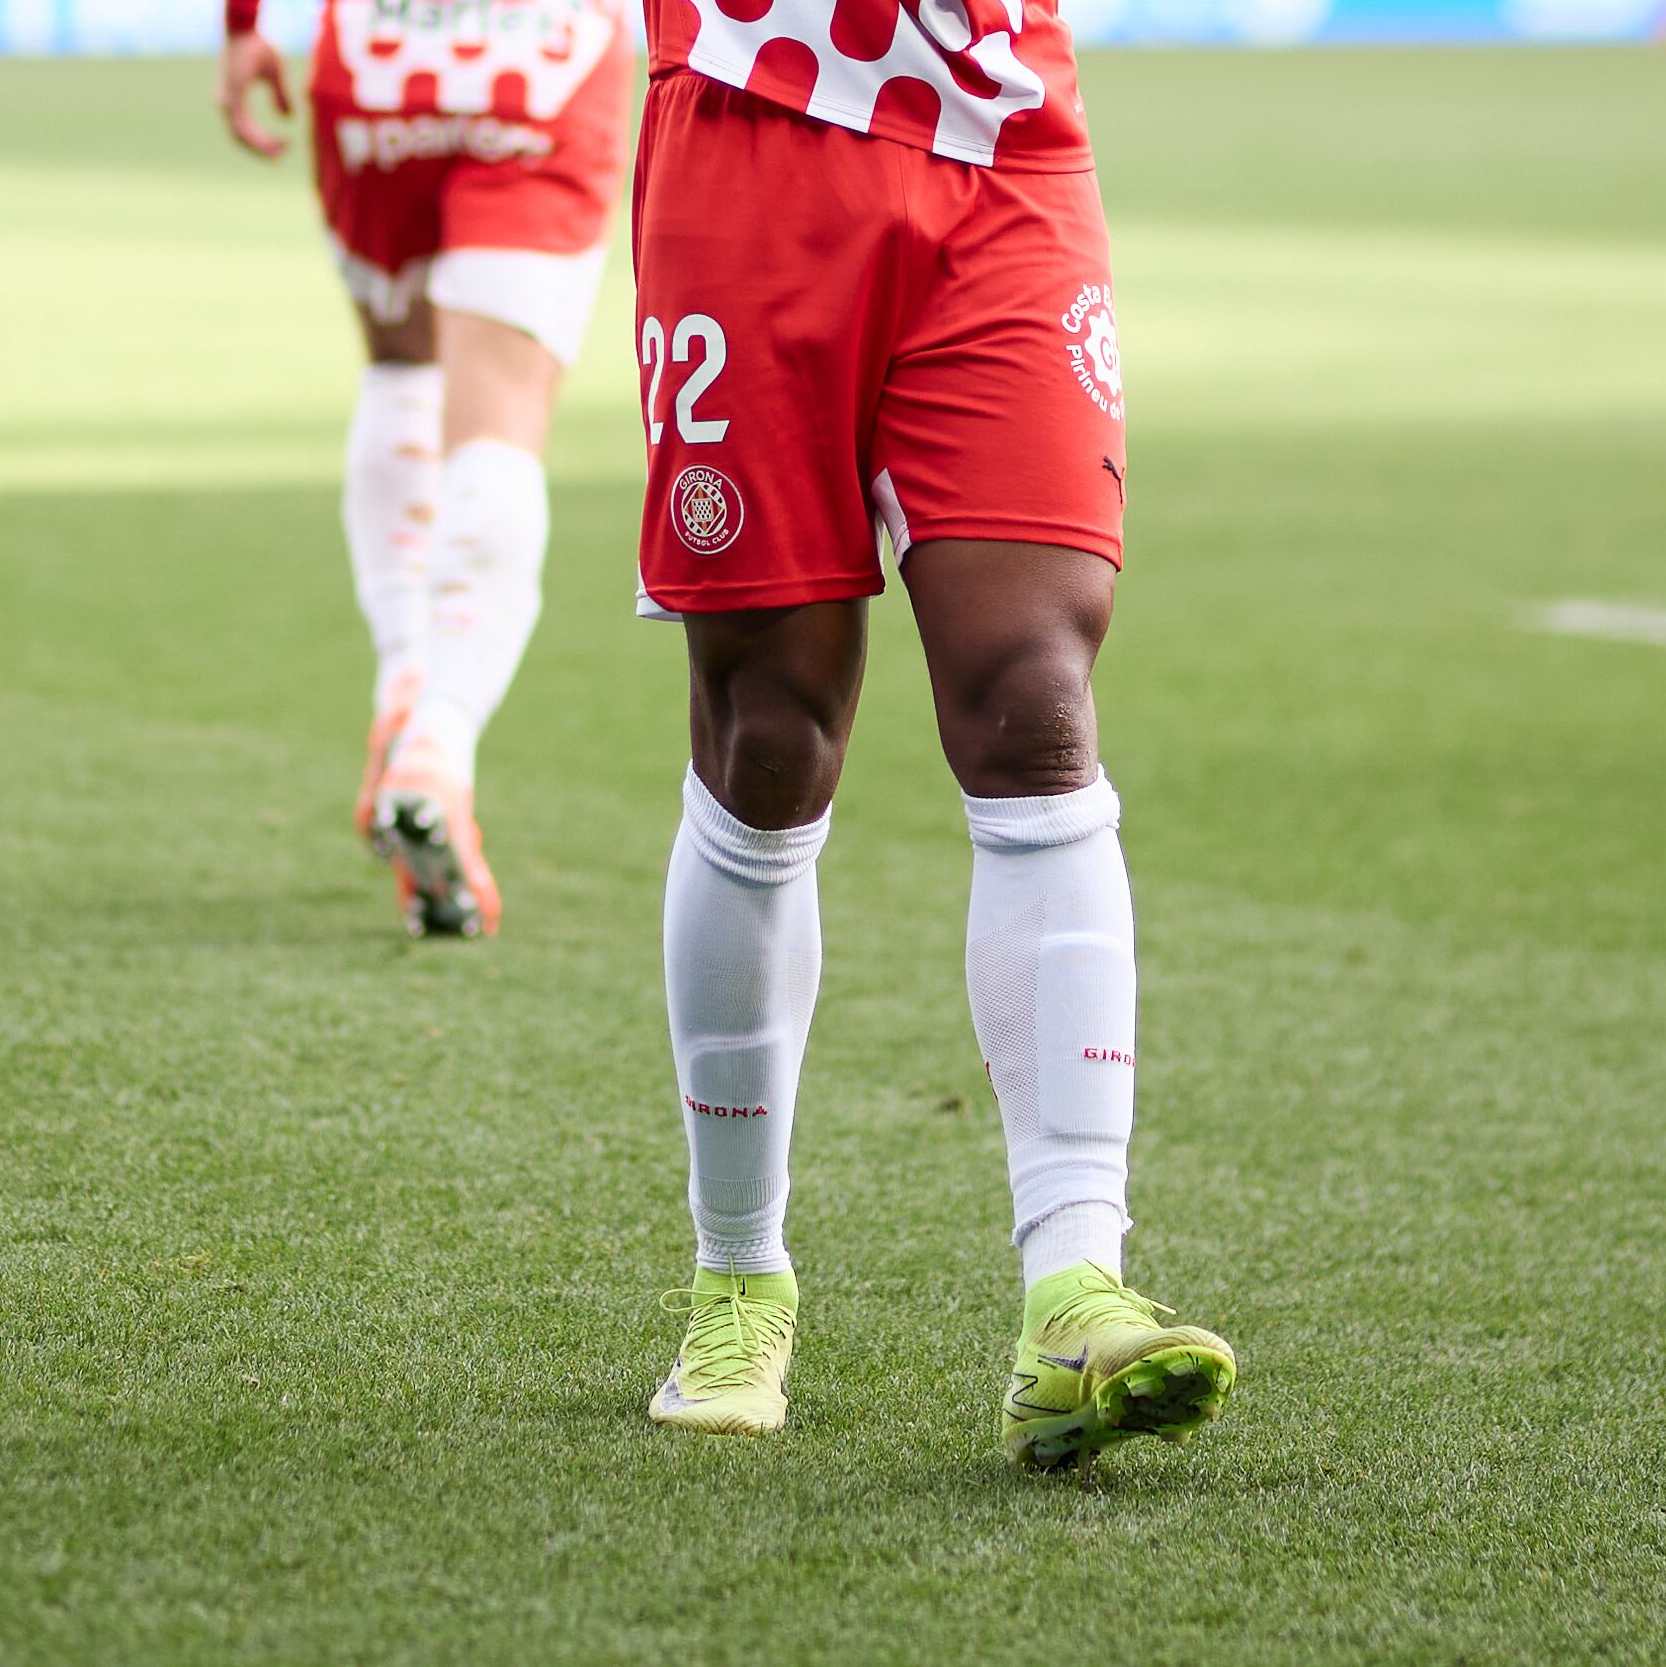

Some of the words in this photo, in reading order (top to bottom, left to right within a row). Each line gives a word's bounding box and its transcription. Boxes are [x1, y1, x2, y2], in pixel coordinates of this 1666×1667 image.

[1061, 283, 1102, 333] Costa
[641, 313, 730, 445] 22
[1066, 344, 1109, 412] Pirineu
[679, 470, 723, 490] GIRONA
[685, 531, 711, 546] FUTBOL
[712, 528, 729, 544] CLUB
